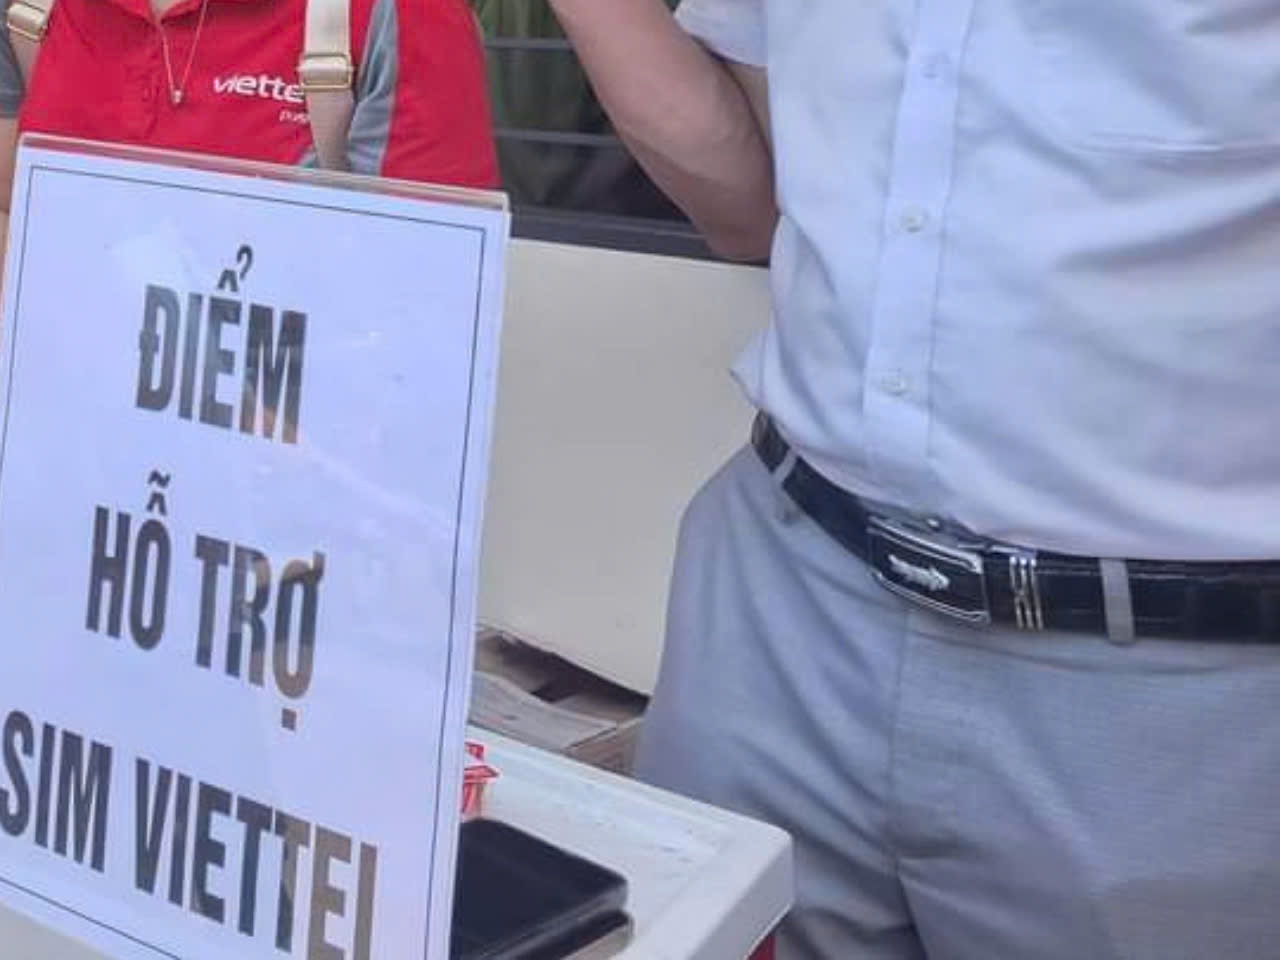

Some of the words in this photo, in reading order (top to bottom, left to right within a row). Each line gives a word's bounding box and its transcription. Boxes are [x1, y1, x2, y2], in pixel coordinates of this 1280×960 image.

[213, 74, 305, 102] viette
[135, 245, 308, 445] ĐIỂM
[84, 470, 172, 651] HỖ
[194, 534, 326, 732] TRỢ
